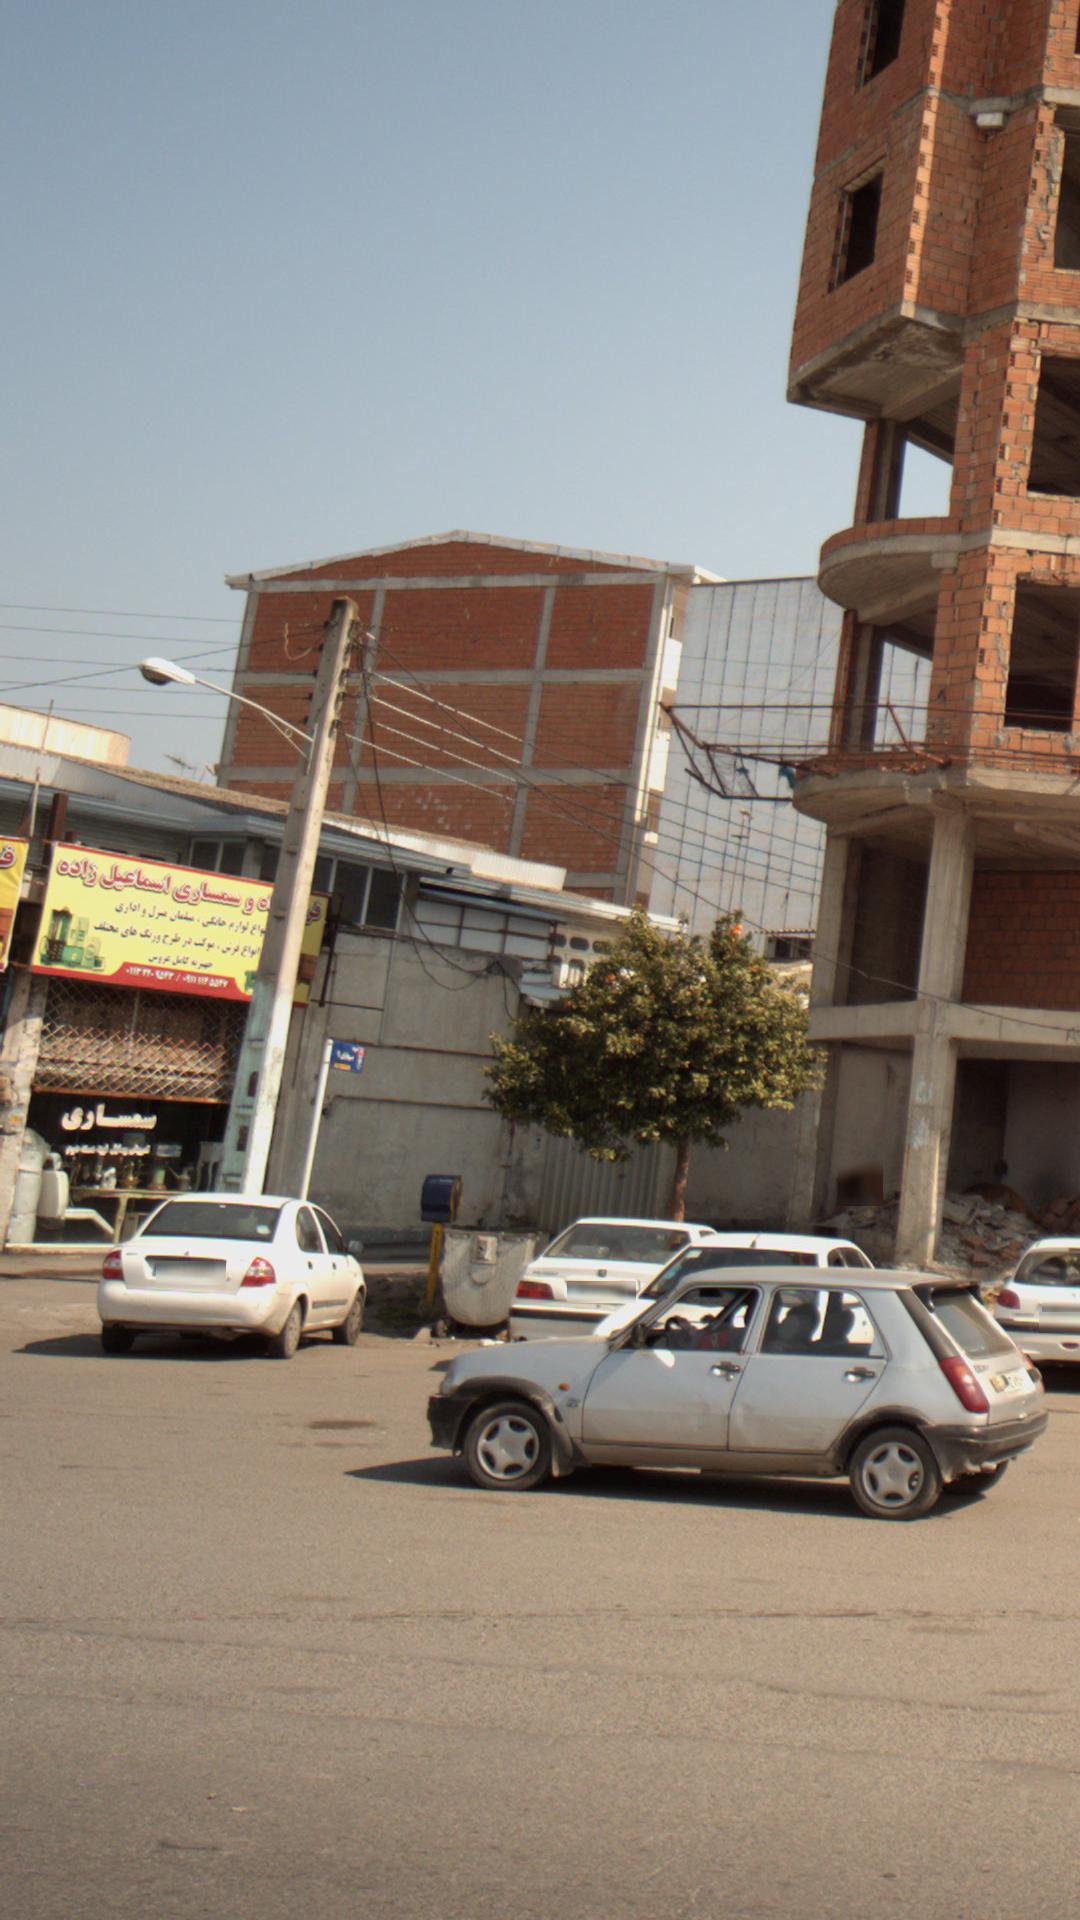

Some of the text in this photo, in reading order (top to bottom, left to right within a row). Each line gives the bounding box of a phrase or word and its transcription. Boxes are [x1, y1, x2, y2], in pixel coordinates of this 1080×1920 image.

[57, 860, 97, 888] زاده
[99, 864, 172, 895] اسماعیل
[172, 880, 241, 907] سمساری
[241, 895, 255, 915] و
[61, 1103, 157, 1131] سمساری
